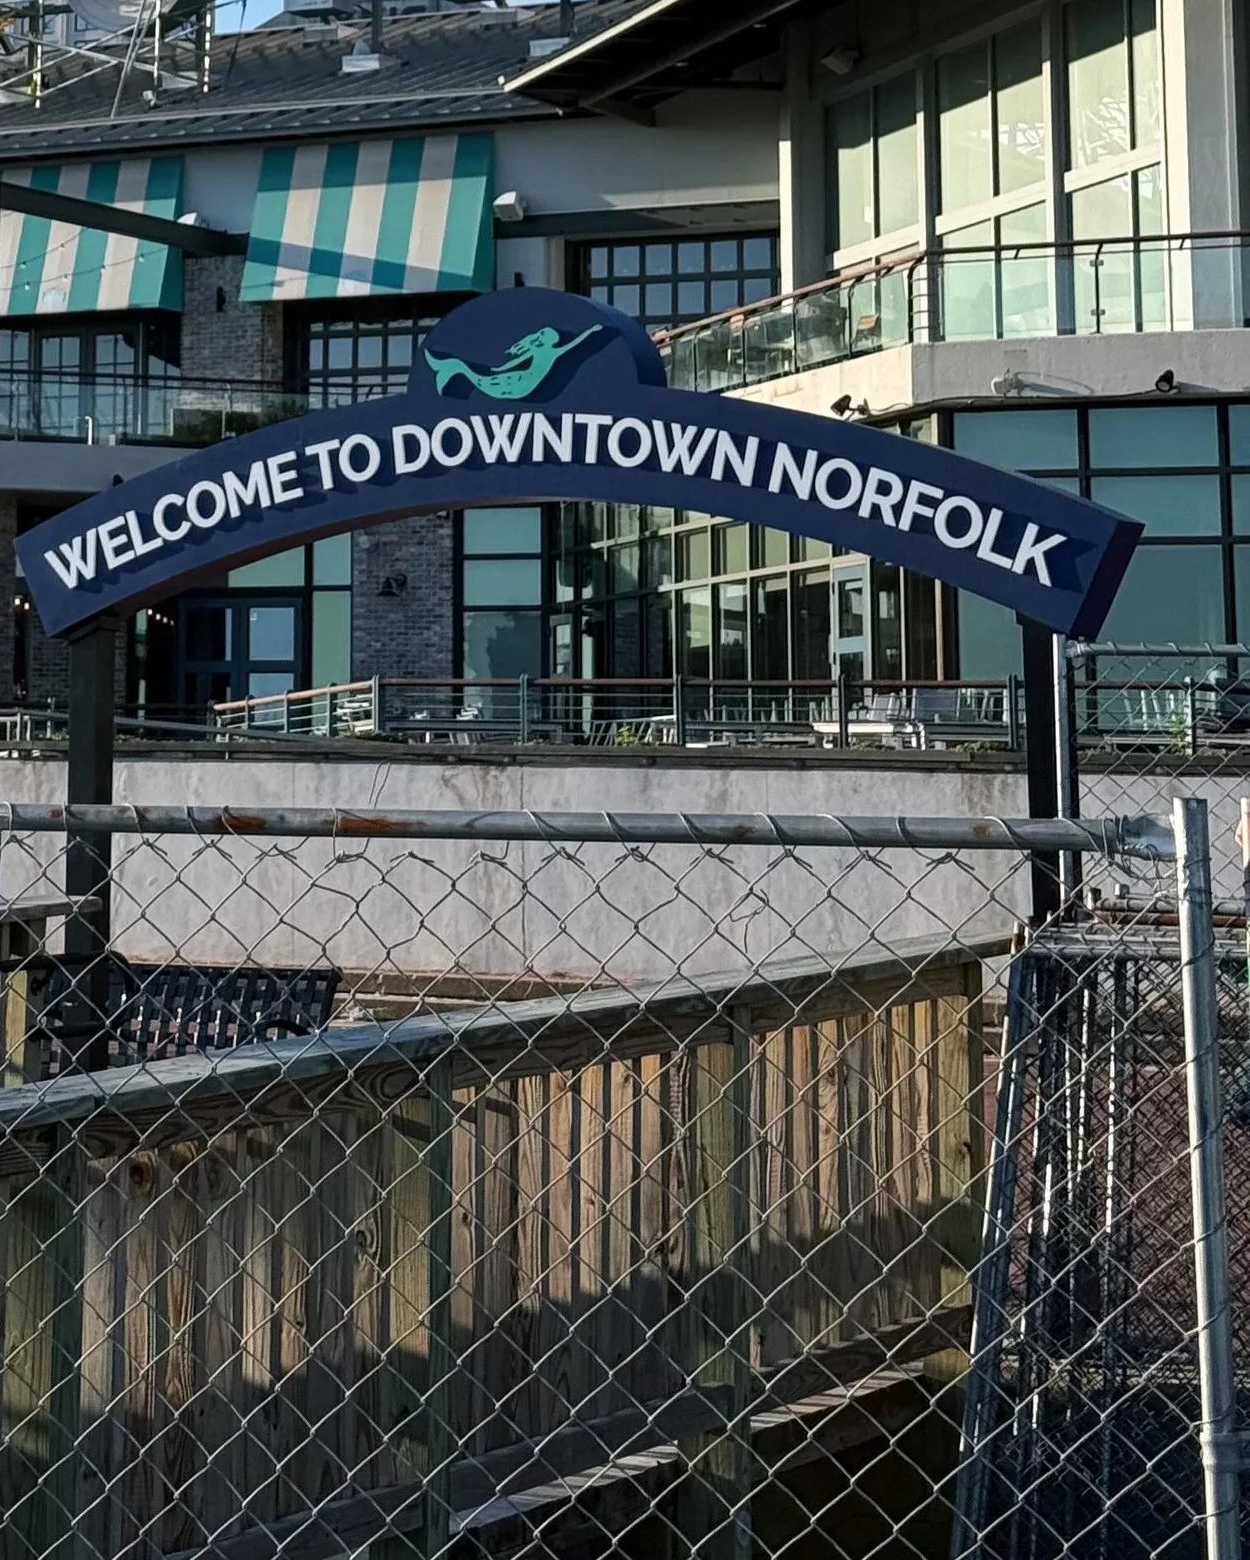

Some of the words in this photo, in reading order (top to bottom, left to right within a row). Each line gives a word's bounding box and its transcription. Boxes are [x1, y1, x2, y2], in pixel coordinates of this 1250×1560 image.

[43, 450, 304, 590] WELCOME
[304, 433, 381, 490] TO
[391, 412, 760, 487] DOWNTOWN
[767, 441, 1069, 588] NORFOLK
